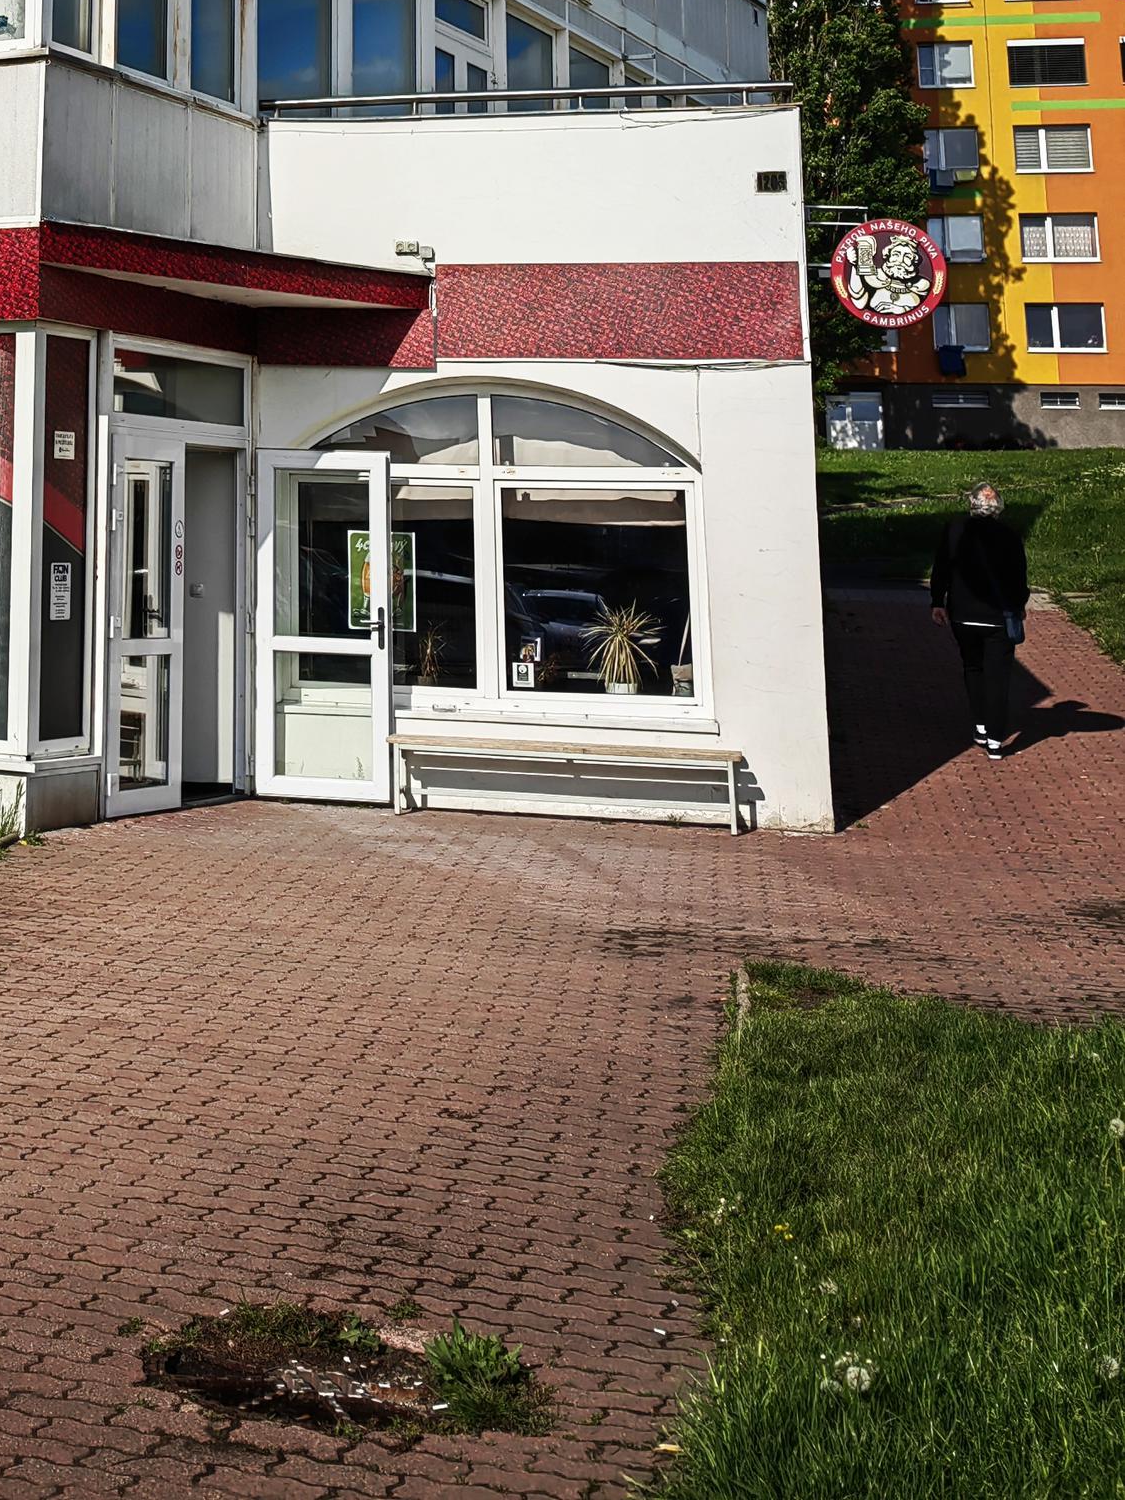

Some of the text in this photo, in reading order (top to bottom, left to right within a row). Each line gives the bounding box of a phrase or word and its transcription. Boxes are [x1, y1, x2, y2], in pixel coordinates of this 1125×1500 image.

[835, 220, 939, 263] PATRON NAŠEHO PIVA
[862, 306, 931, 326] GAMBRINUS
